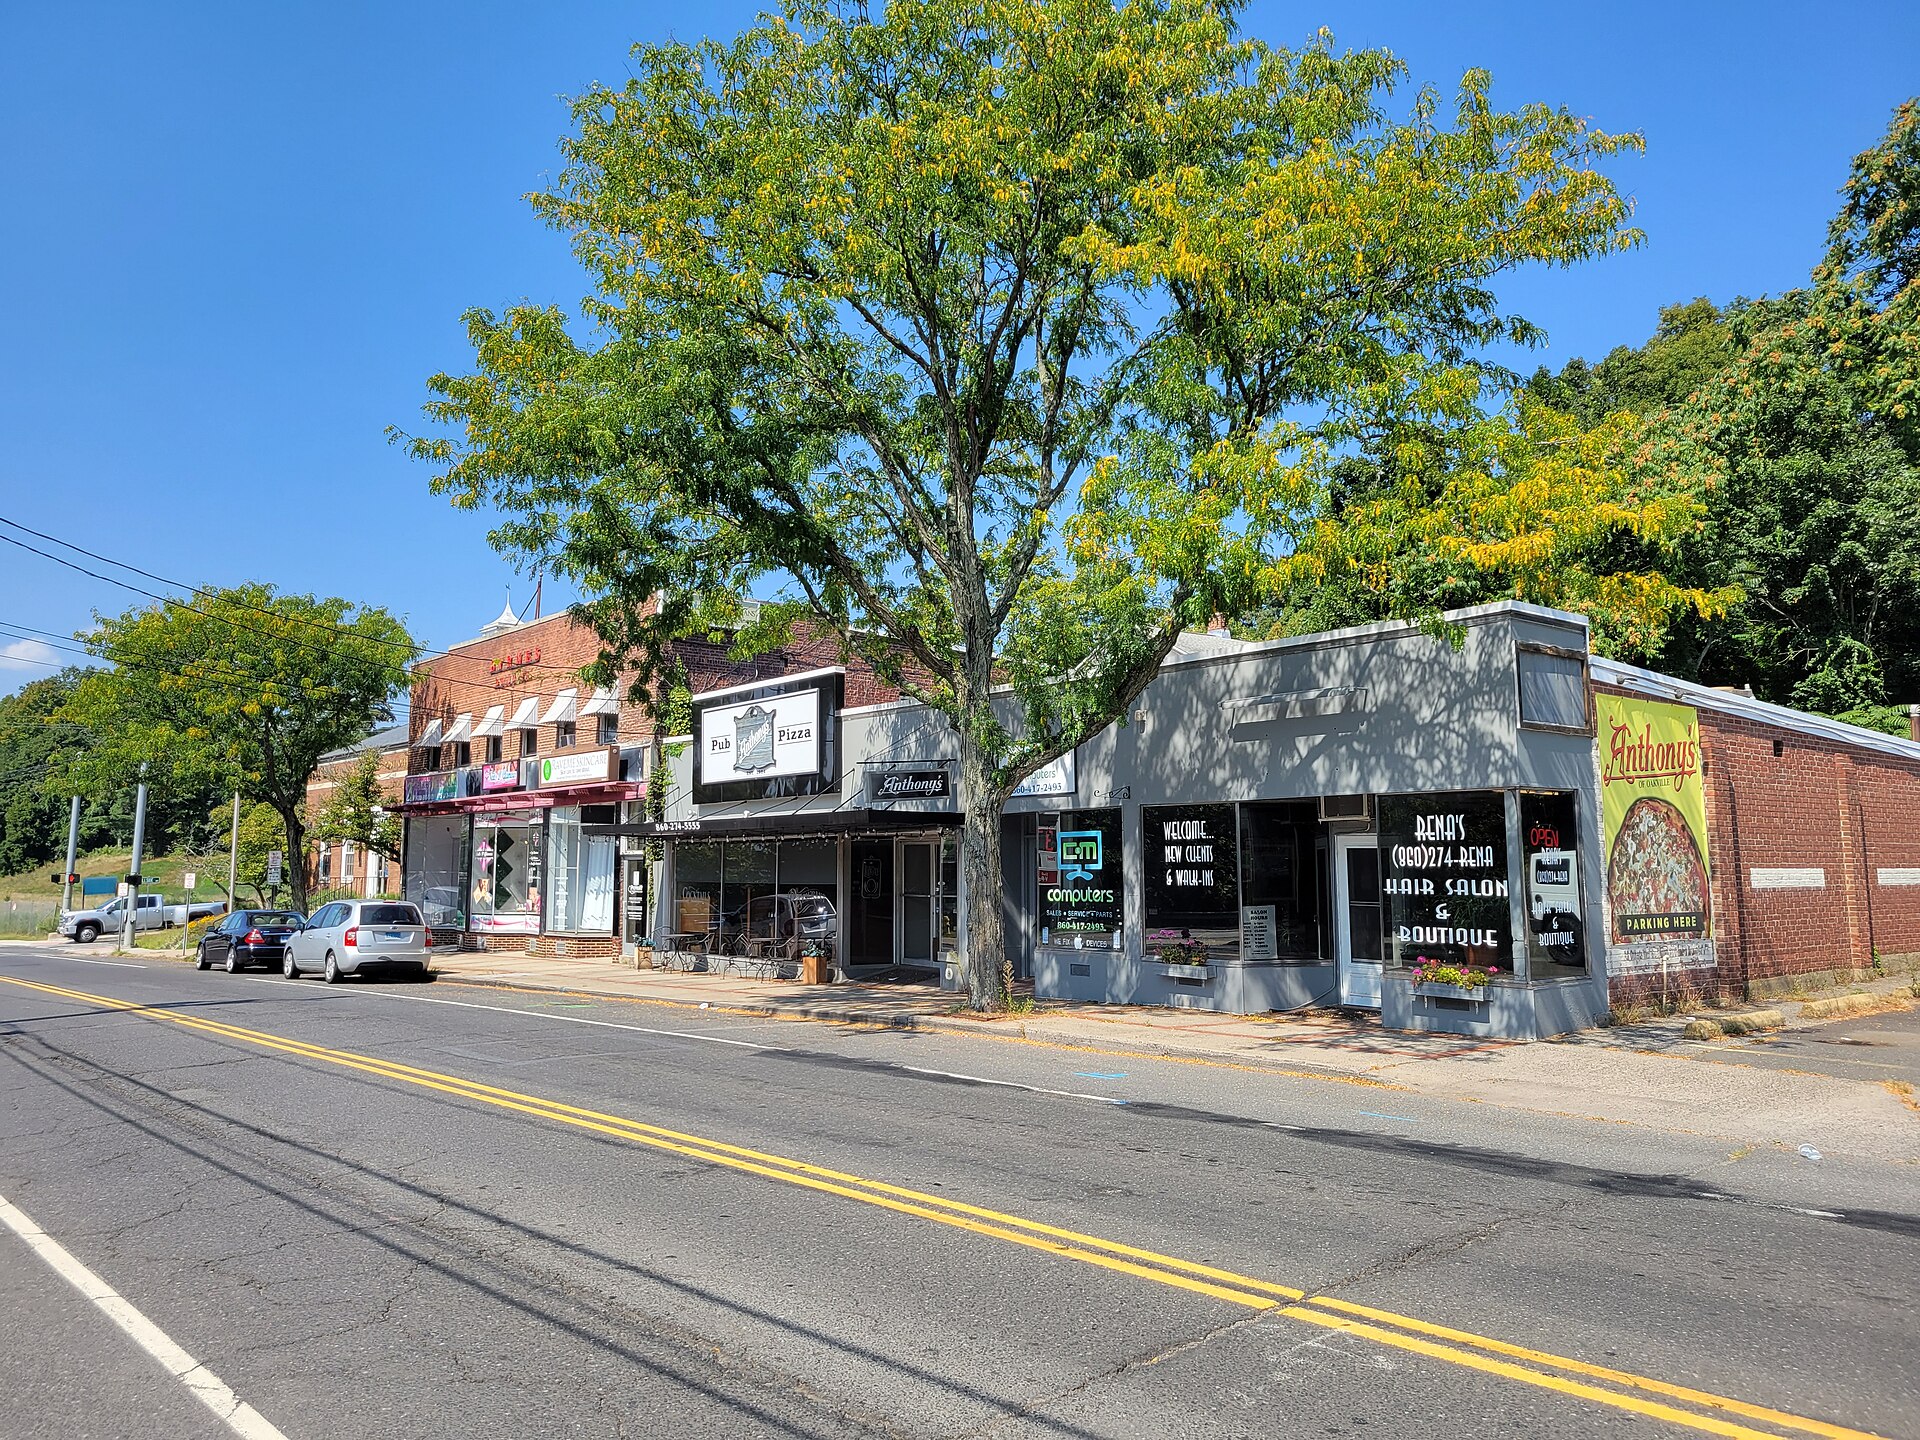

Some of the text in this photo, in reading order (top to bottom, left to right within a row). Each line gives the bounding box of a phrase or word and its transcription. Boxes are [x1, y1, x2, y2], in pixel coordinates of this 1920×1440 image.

[711, 728, 812, 751] Pub Pizza
[737, 716, 771, 764] Anthony's
[1603, 715, 1697, 792] Anthony's
[877, 774, 944, 796] Anthony's
[1638, 779, 1671, 788] OF OAKVILLE
[1163, 820, 1215, 841] WELCOME...
[1414, 814, 1466, 841] RENA'S
[1530, 827, 1559, 847] OPEN
[1164, 845, 1214, 863] NEW CLIENTS
[1392, 843, 1494, 869] (860)274-RENA
[1166, 868, 1214, 887] & WALK-INS
[1047, 886, 1114, 907] computers
[1383, 878, 1509, 897] HAIR SALON
[1046, 909, 1062, 917] SALES
[1435, 903, 1452, 920] &
[1057, 921, 1104, 931] 860-417-2493
[1552, 916, 1559, 930] &
[1626, 916, 1697, 931] PARKING HERE
[1085, 939, 1108, 948] DEVICES
[1396, 925, 1498, 947] BOUTIQUE
[1538, 931, 1575, 947] BOUTIQUE
